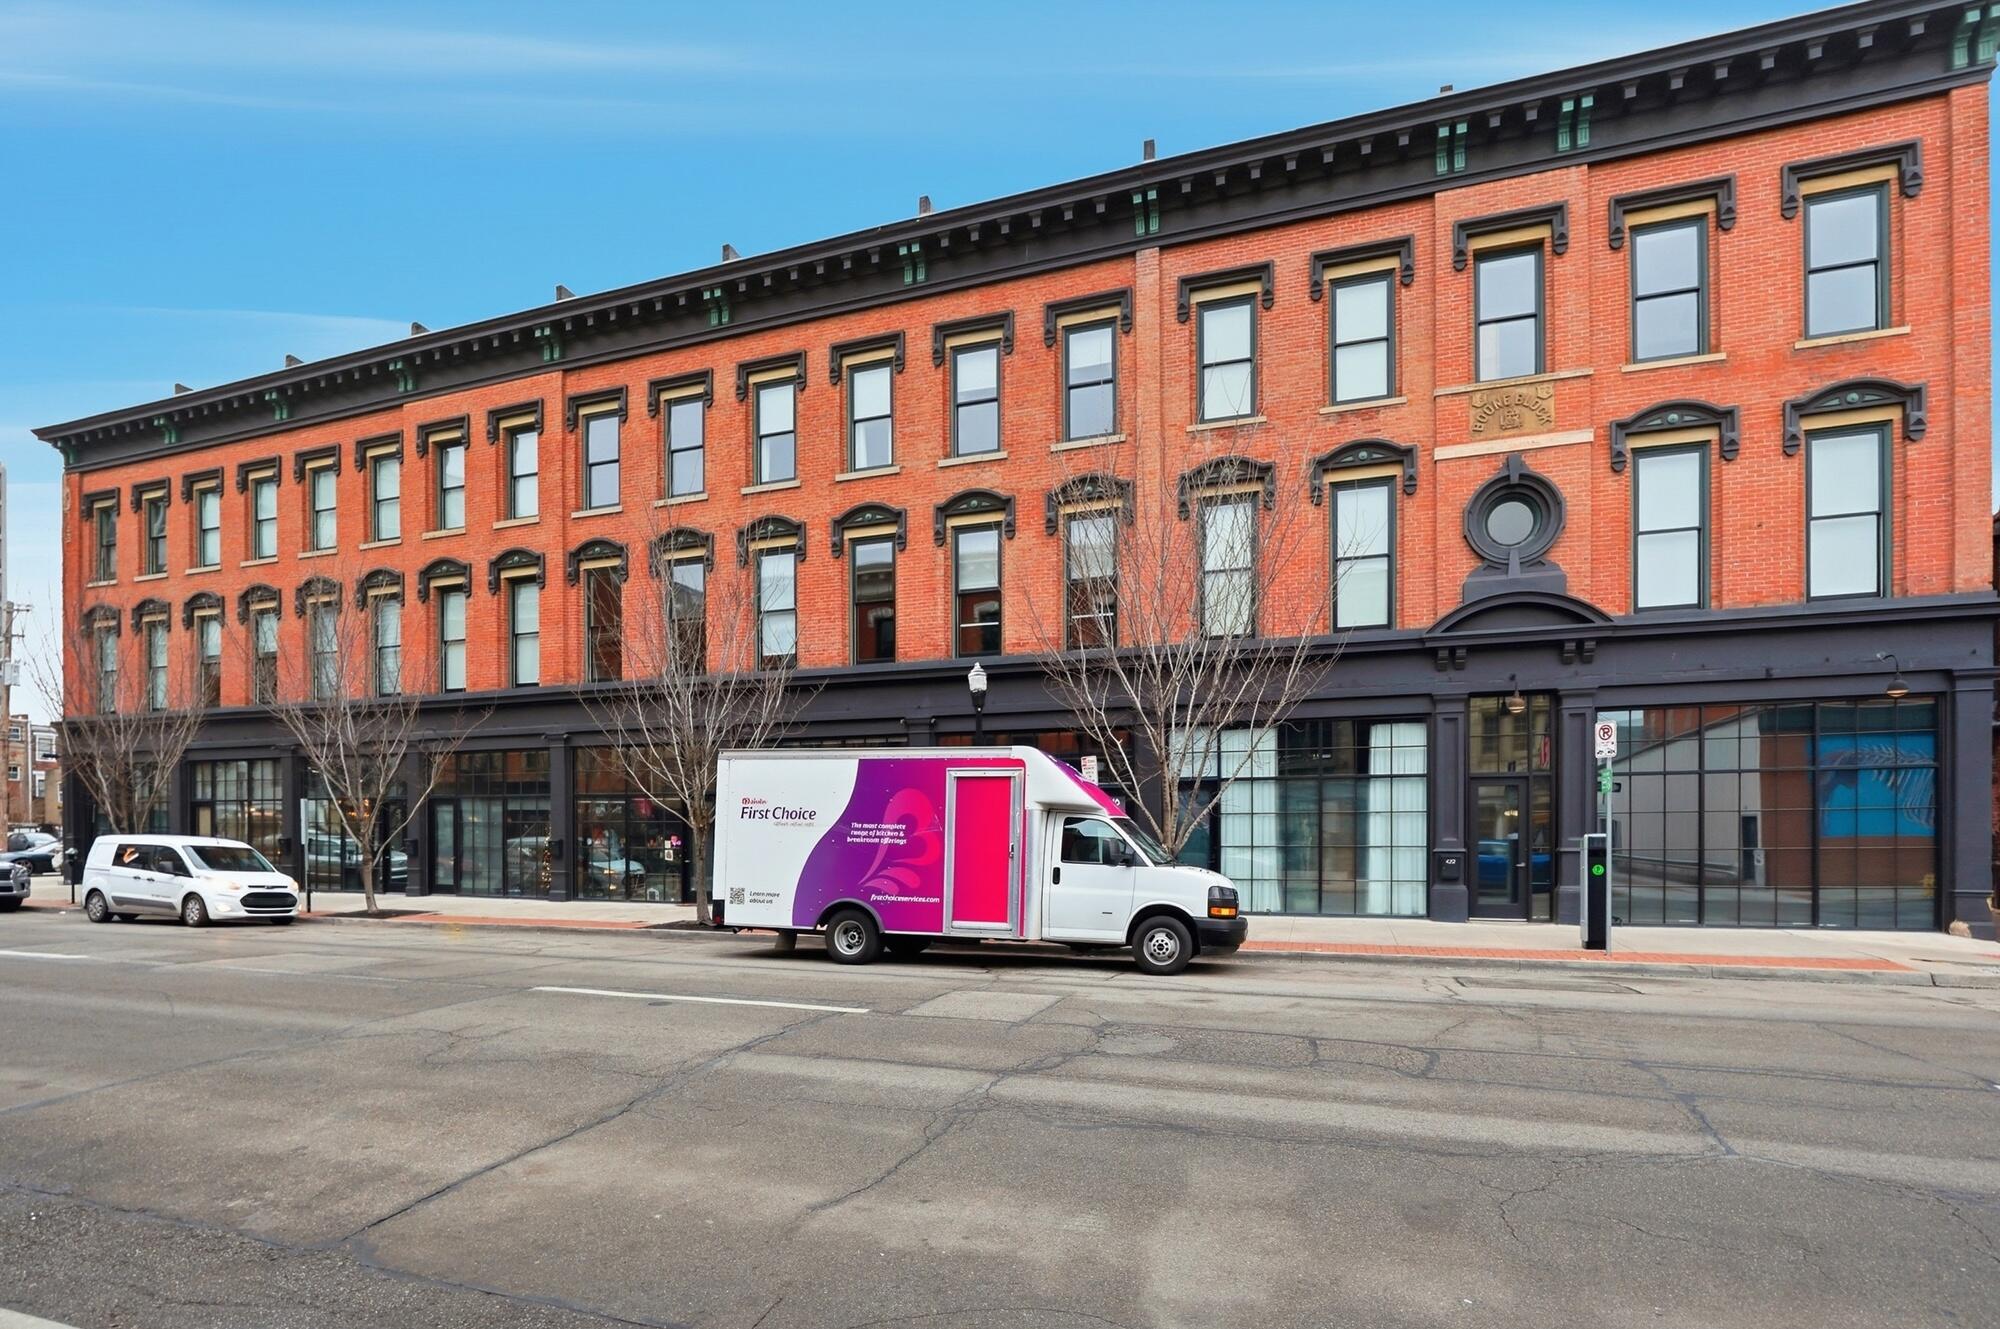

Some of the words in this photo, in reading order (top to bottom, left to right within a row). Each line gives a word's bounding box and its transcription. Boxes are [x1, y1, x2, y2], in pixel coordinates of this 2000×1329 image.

[1472, 393, 1511, 432] BOONE
[1515, 393, 1552, 426] BLOCK
[740, 806, 771, 820] First
[772, 806, 817, 820] Choice
[880, 837, 907, 845] offerings
[870, 893, 940, 903] firstchoiceservices.com
